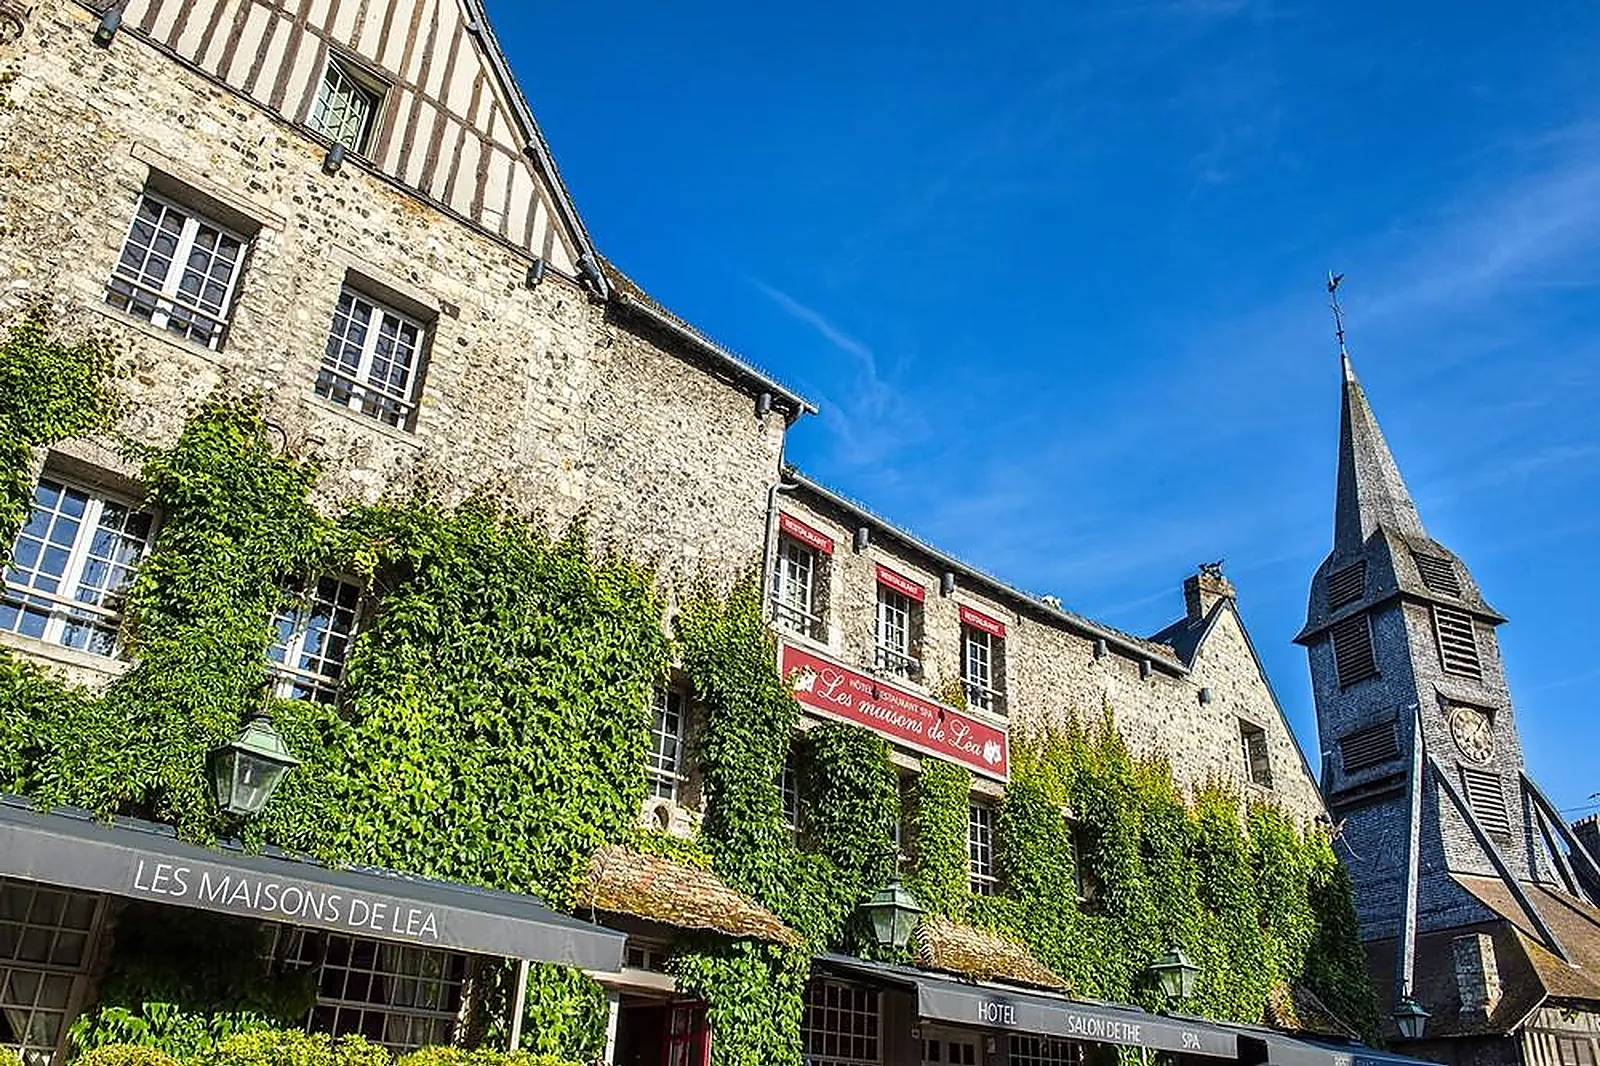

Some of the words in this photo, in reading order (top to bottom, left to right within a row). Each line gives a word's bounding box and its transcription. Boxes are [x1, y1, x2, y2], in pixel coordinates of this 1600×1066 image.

[818, 668, 852, 706] Les
[859, 700, 922, 734] maisons
[927, 718, 946, 743] de
[949, 719, 982, 756] Léa
[133, 859, 191, 897] LES
[197, 871, 342, 923] MAISONS
[347, 899, 389, 931] DE
[391, 903, 439, 940] LEA
[977, 1000, 1018, 1026] HOTEL
[1067, 1014, 1107, 1039] SALON
[1106, 1020, 1122, 1041] DE
[1121, 1023, 1142, 1043] THE
[1181, 1031, 1202, 1050] SPA
